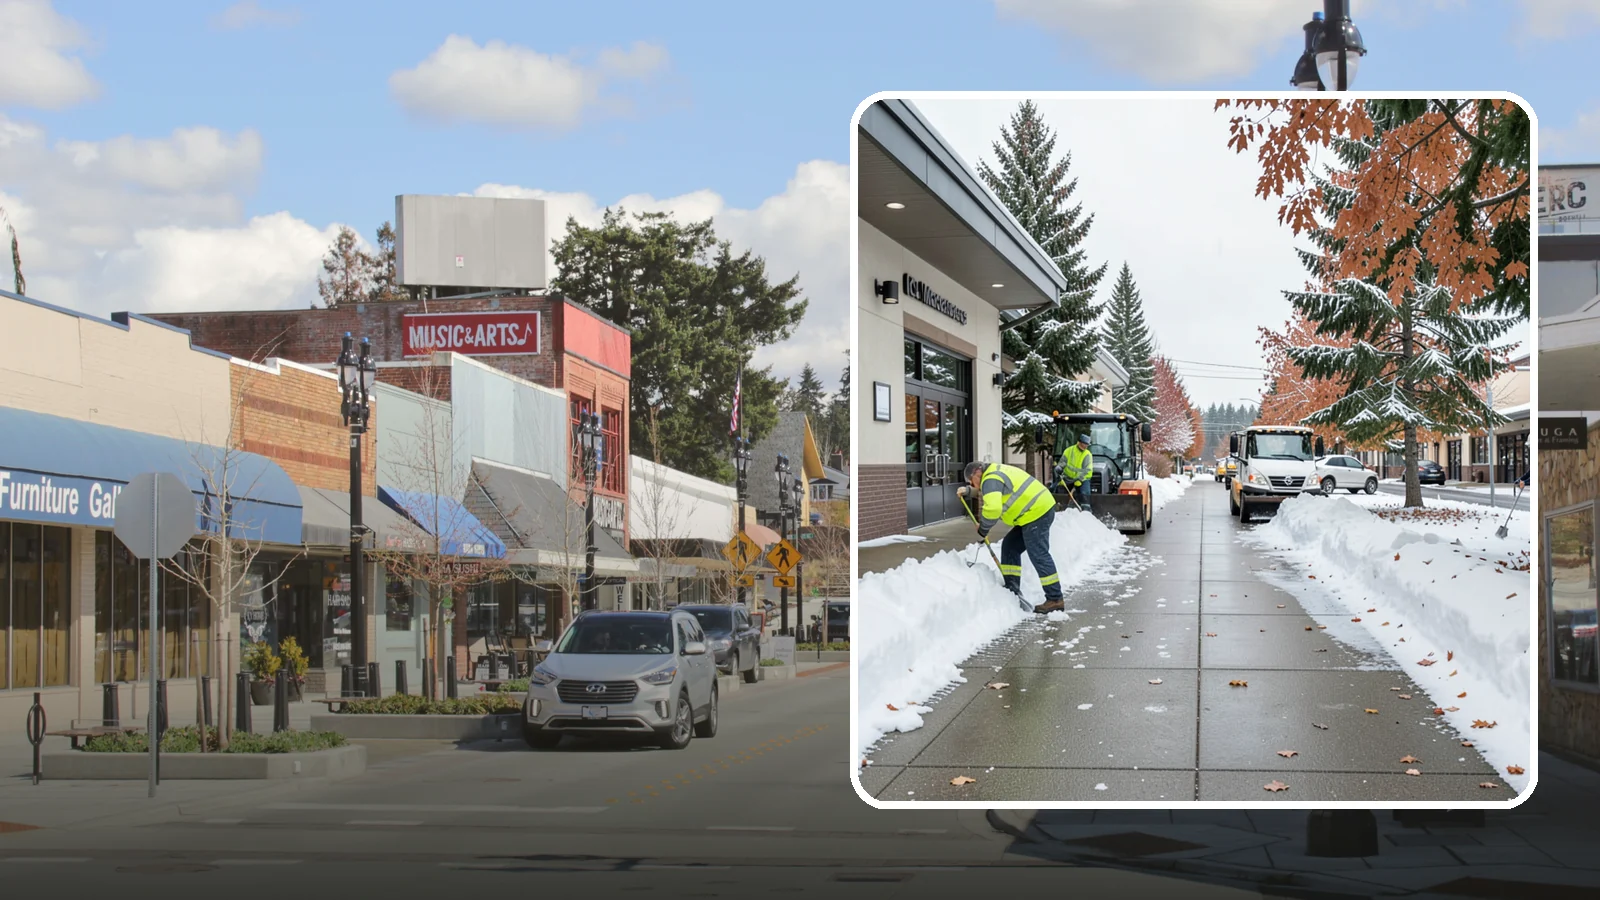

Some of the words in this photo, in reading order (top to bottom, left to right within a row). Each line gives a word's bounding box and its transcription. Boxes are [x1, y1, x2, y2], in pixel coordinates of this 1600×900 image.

[1541, 428, 1577, 437] UGA
[0, 471, 80, 515] Furniture
[89, 482, 122, 519] Gal
